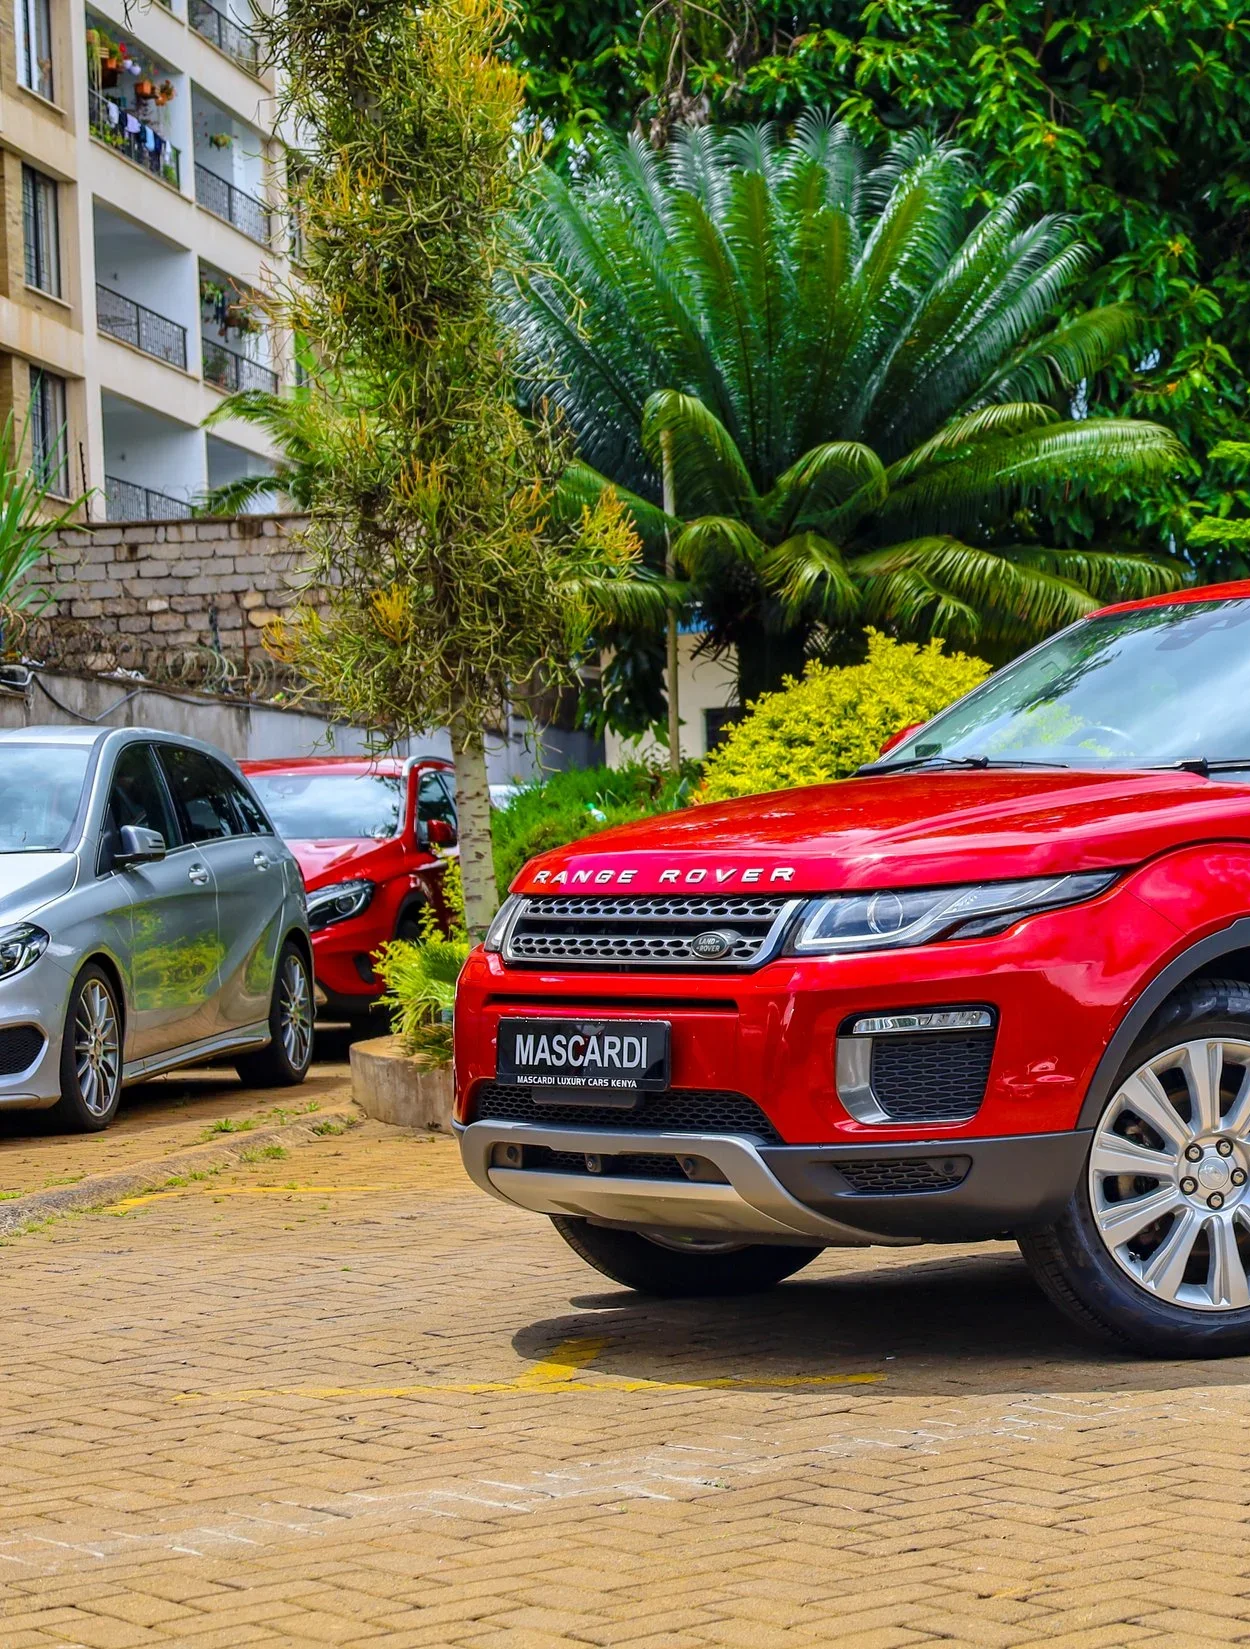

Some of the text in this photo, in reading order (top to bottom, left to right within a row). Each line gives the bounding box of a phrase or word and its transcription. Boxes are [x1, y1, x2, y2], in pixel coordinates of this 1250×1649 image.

[532, 867, 796, 884] RANGE ROVER
[515, 1034, 647, 1068] MASCARDI
[517, 1075, 637, 1088] MASCARDI LUXURY CARS KENYA
